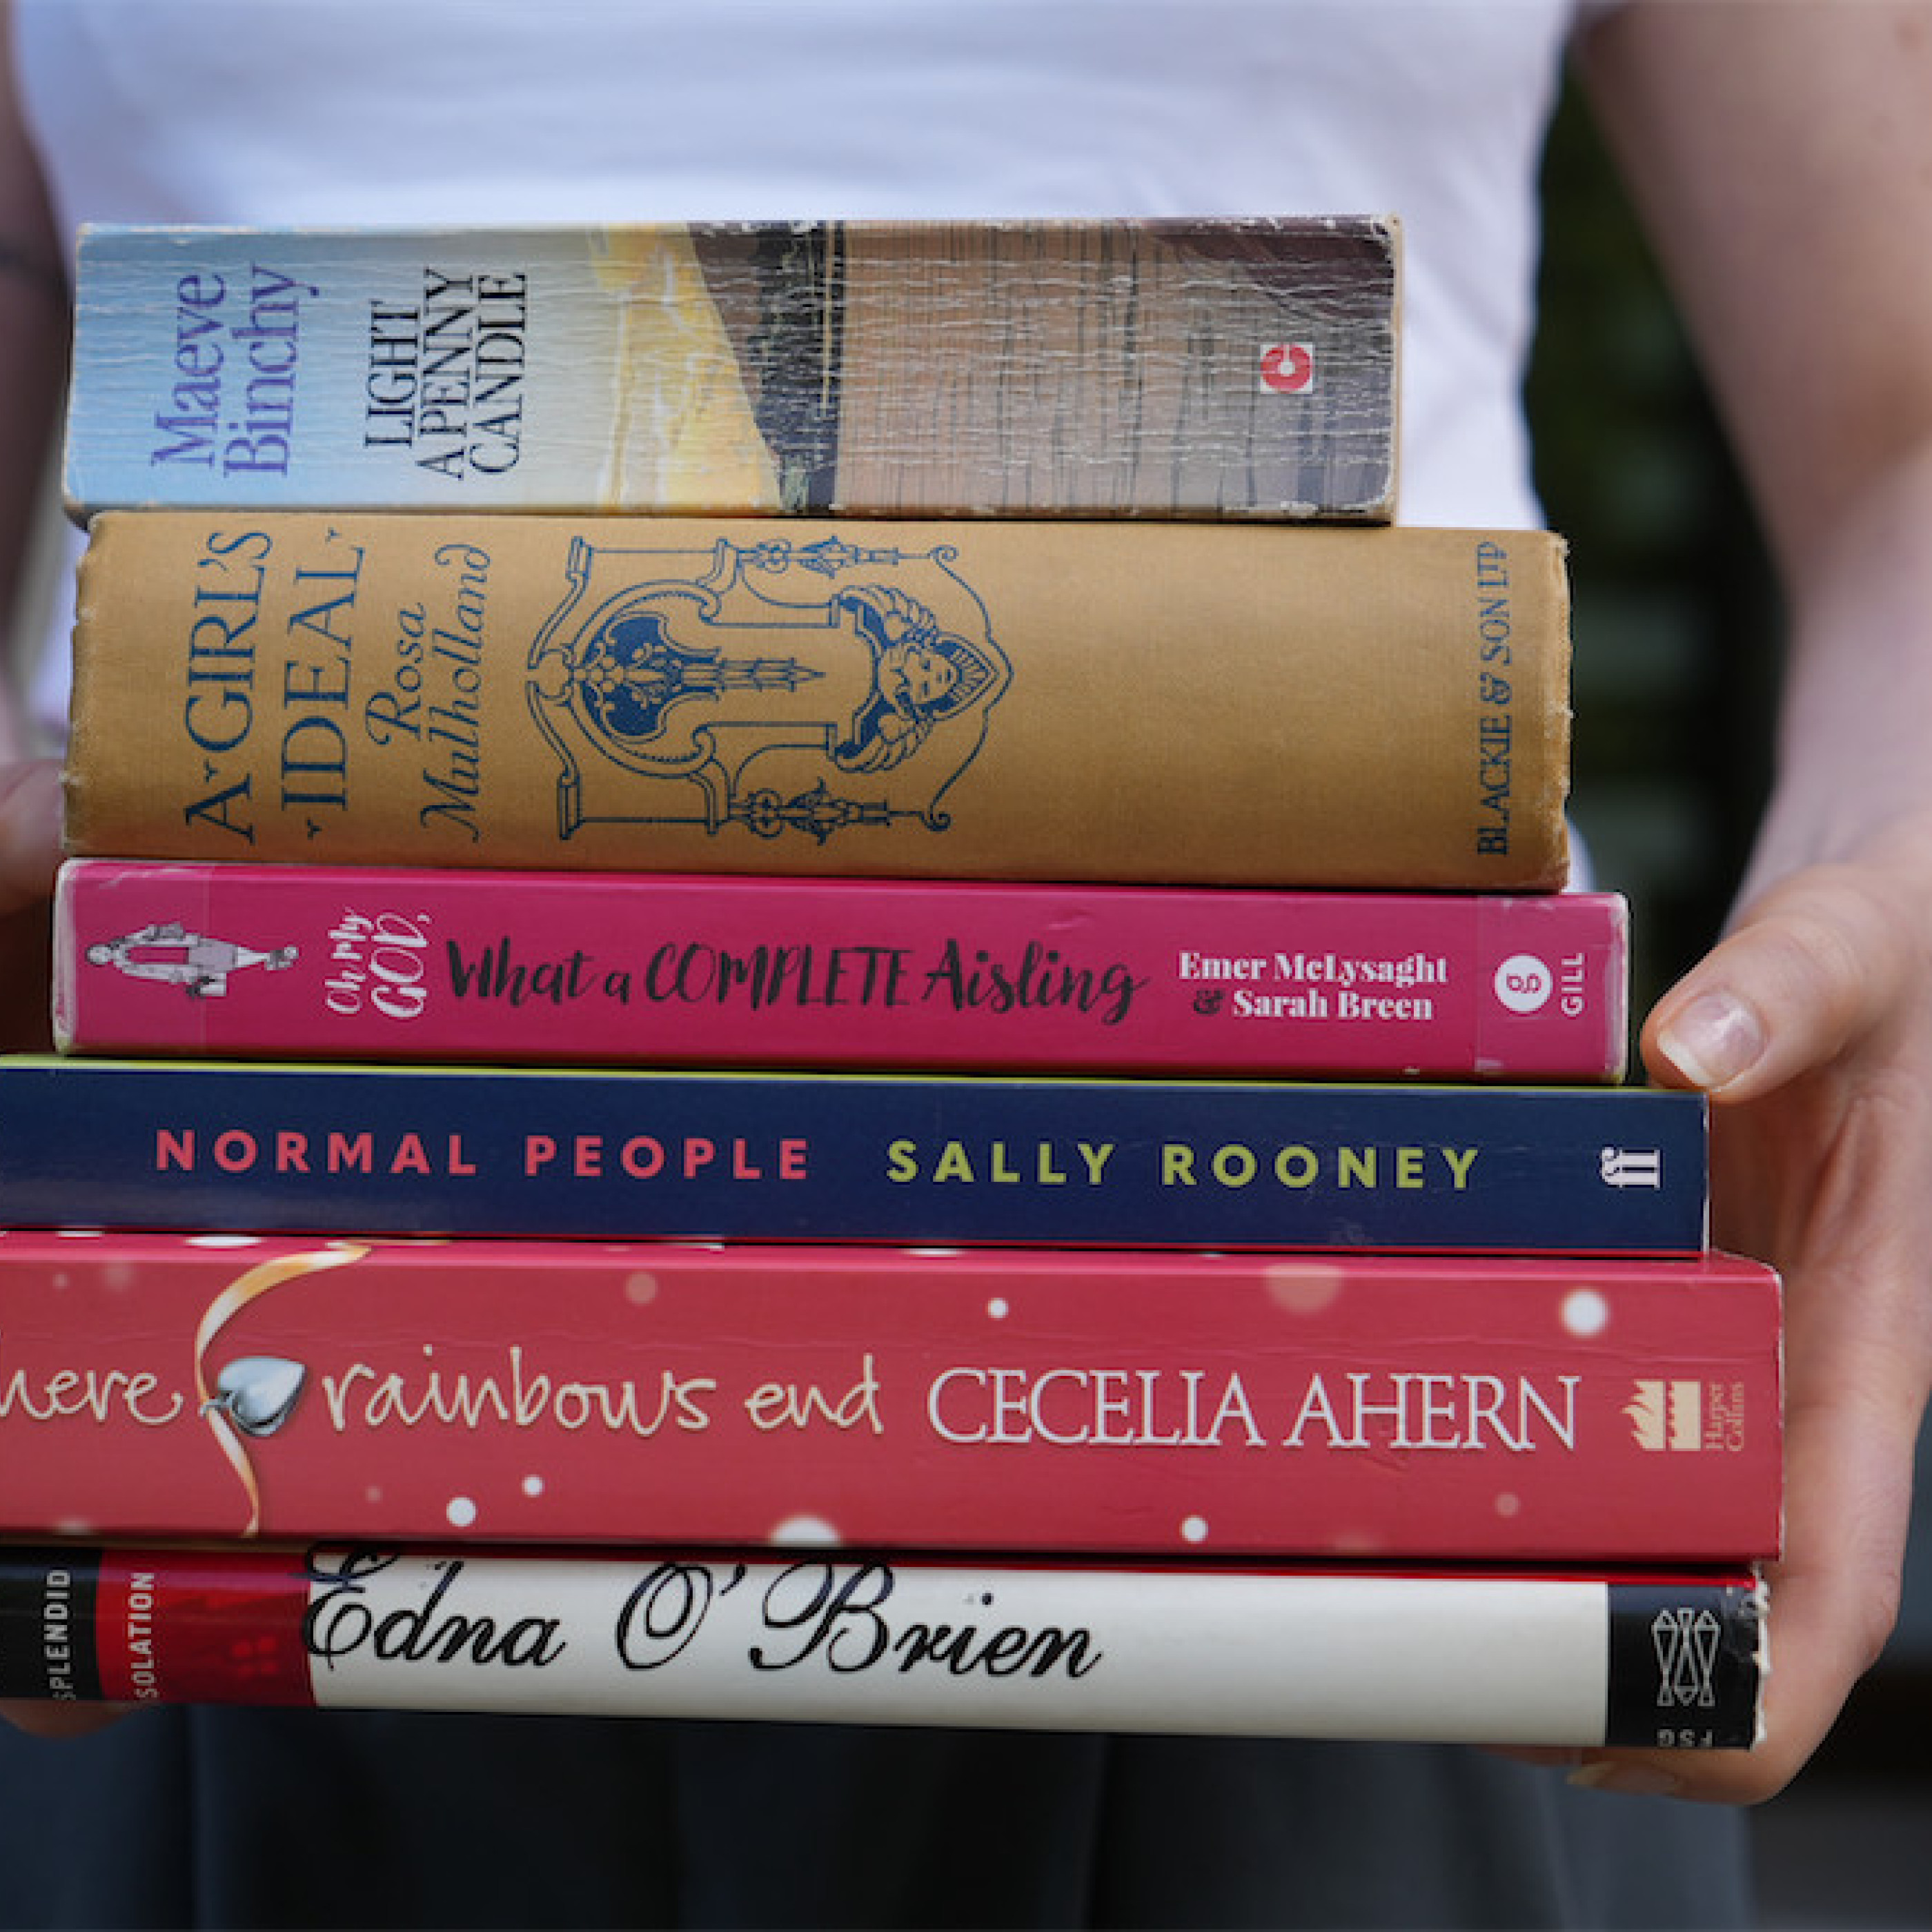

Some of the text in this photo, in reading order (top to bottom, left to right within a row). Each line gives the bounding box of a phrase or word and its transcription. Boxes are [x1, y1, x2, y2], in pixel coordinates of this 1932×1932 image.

[151, 274, 226, 467] Maeve
[224, 266, 319, 477] Binchy
[364, 299, 420, 448] LIGHT
[416, 268, 474, 481] A PENNY
[469, 273, 530, 475] CANDLE
[282, 546, 364, 811] IDEAL
[366, 602, 426, 746] Rosa
[1477, 598, 1510, 667] SON
[186, 531, 273, 846] A GIRL'S
[420, 542, 491, 843] Mulholland
[1479, 671, 1511, 704] &
[1477, 715, 1510, 856] BLACKIE
[325, 970, 365, 1014] Oh
[369, 912, 432, 1018] GOD,
[446, 936, 1150, 1026] What a COMPLETE Aisling
[1179, 952, 1448, 987] Emer McLysaght
[1193, 989, 1434, 1020] & Sarah Breen
[1561, 952, 1585, 1017] GILL
[155, 1129, 809, 1181] NORMAL PEOPLE
[886, 1140, 1480, 1190] SALLY ROONEY
[322, 1344, 718, 1437] rainbows
[744, 1352, 884, 1435] end
[926, 1367, 1582, 1453] CECELIA AHERN
[1705, 1380, 1726, 1451] Harper
[1724, 1380, 1745, 1451] Collins
[301, 1541, 1102, 1679] Edna O'Brien
